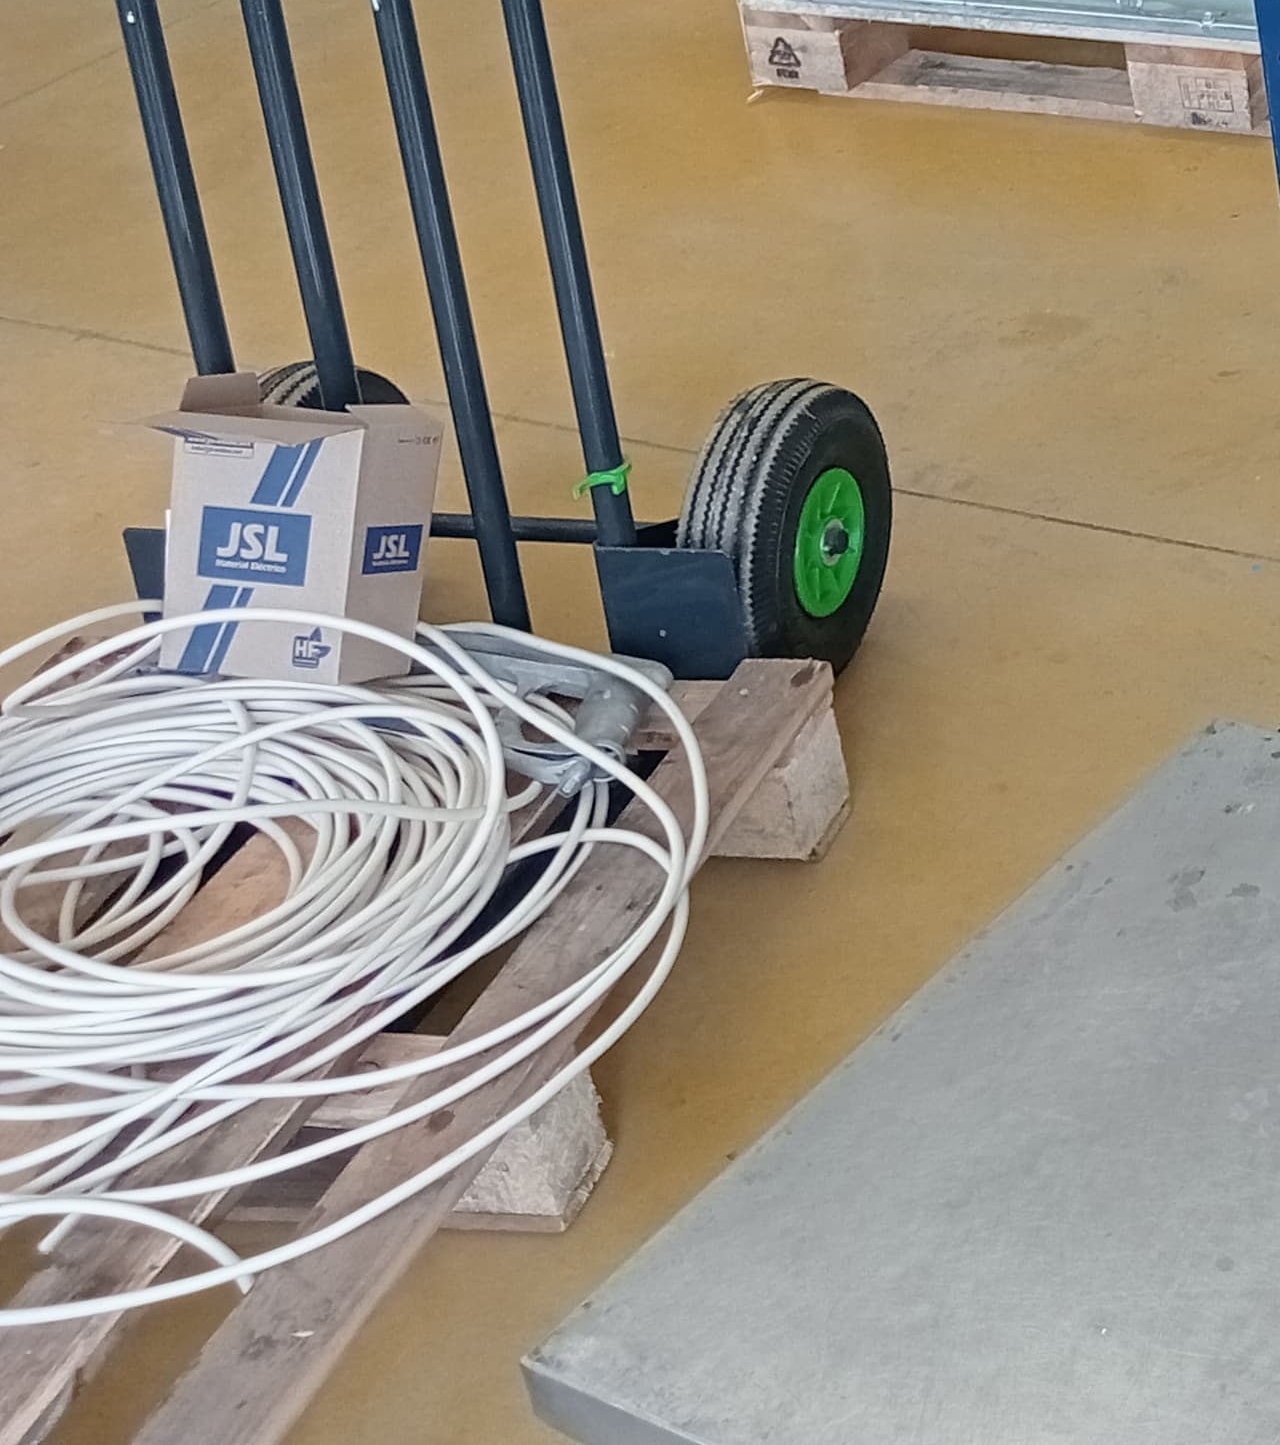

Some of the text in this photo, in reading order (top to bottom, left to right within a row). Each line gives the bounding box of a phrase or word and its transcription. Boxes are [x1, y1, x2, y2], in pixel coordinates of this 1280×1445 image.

[216, 522, 288, 563] JSL
[372, 533, 410, 560] JSL
[294, 638, 320, 657] HF
